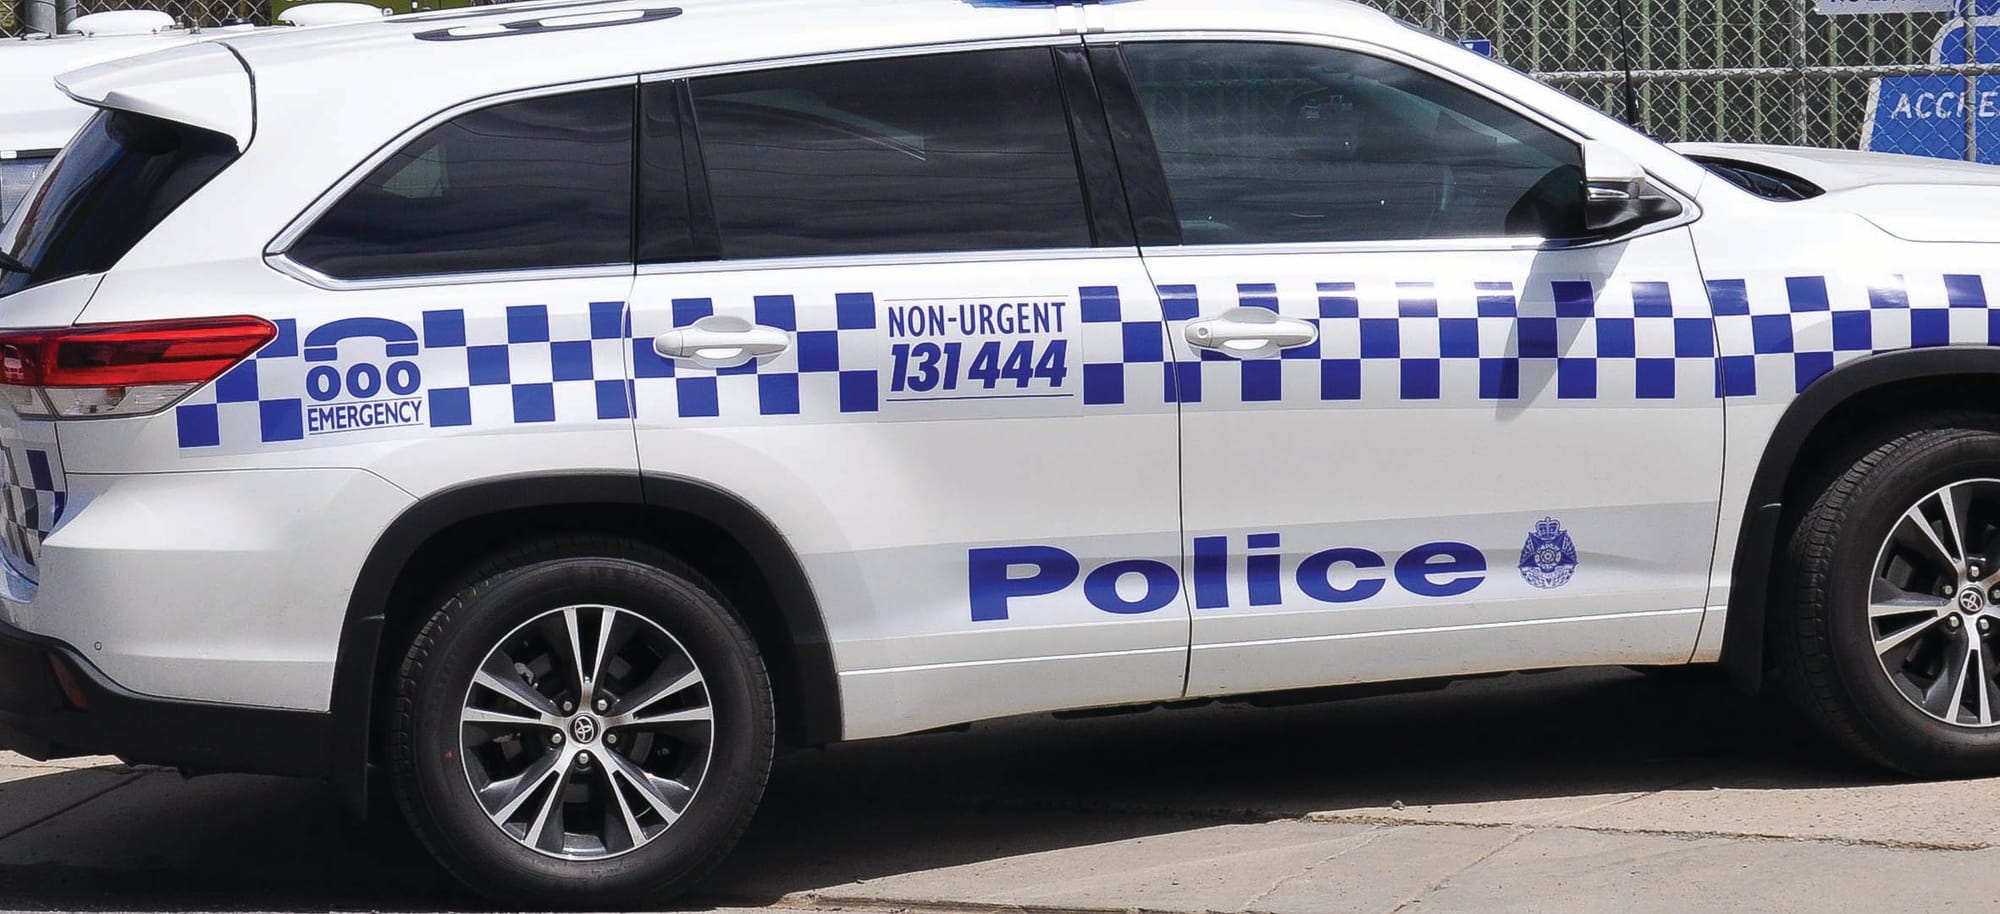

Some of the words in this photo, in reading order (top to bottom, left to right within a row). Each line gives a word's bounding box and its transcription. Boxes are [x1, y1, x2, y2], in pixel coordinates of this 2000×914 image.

[888, 302, 1066, 338] NON-URGENT
[890, 341, 962, 392] 131
[967, 339, 1068, 389] 444
[308, 401, 422, 432] EMERGENCY
[968, 532, 1488, 622] Police
